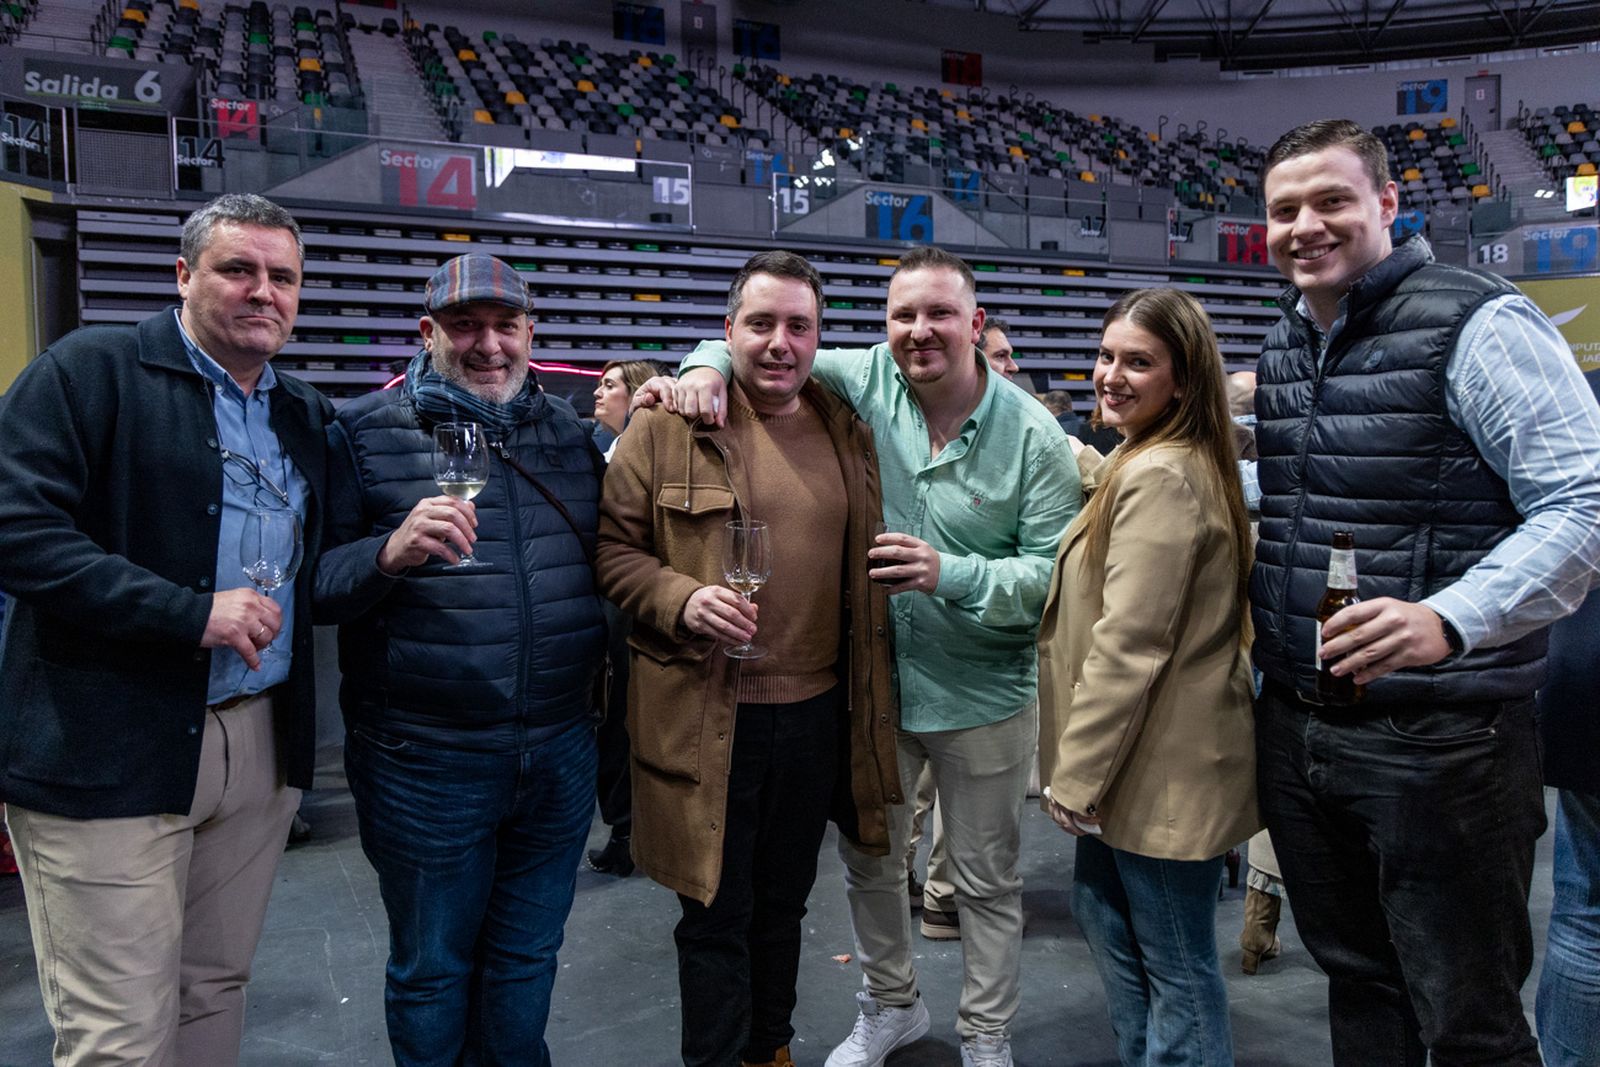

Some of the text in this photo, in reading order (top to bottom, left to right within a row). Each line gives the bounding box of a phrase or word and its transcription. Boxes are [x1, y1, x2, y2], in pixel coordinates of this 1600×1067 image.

[24, 70, 162, 103] Salida 6
[1405, 79, 1448, 114] 19
[211, 98, 250, 111] Sector
[1, 132, 38, 149] Sector
[4, 113, 50, 153] 14
[176, 154, 214, 166] Sector
[182, 137, 226, 168] 14
[380, 149, 441, 170] Sector
[399, 151, 477, 210] 14
[656, 176, 689, 205] 15
[778, 187, 809, 214] 15
[865, 191, 909, 208] Sector
[877, 191, 933, 244] 16
[1084, 216, 1106, 238] 17
[1217, 222, 1251, 236] Sector
[1171, 222, 1193, 243] 17
[1227, 223, 1268, 266] 18
[1523, 229, 1570, 242] Sector
[1480, 243, 1509, 265] 18
[1536, 227, 1598, 273] 19
